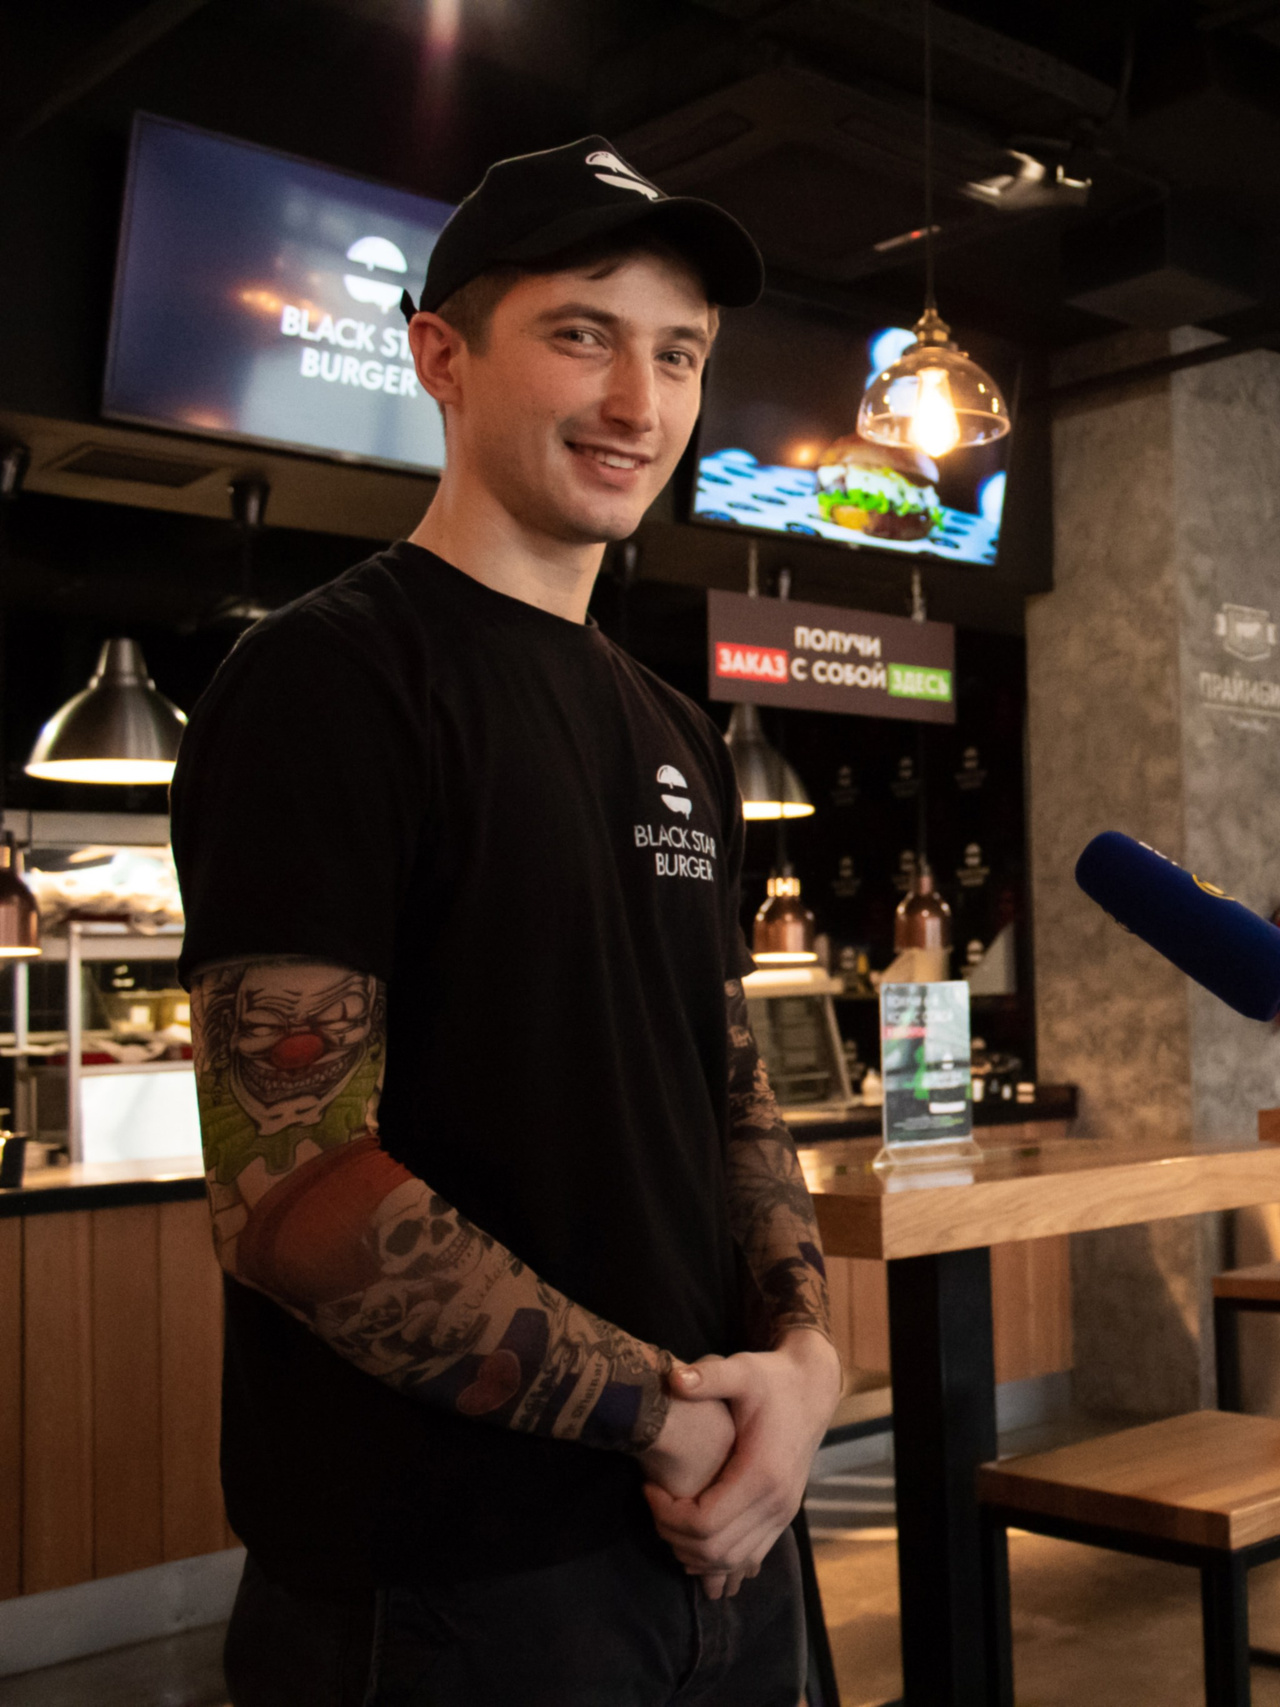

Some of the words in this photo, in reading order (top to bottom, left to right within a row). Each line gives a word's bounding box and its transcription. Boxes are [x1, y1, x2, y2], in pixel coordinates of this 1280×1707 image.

[281, 304, 376, 353] BLACK
[380, 327, 414, 362] ST
[301, 347, 418, 398] BURGER
[794, 625, 882, 658] ПОЛУЧИ
[718, 648, 787, 678] ЗАКАЗ
[790, 657, 809, 682] С
[811, 660, 887, 690] СОБОЙ
[892, 670, 950, 696] ЗДЕСЬ
[634, 824, 691, 850] BLACK
[655, 852, 714, 882] BURGER
